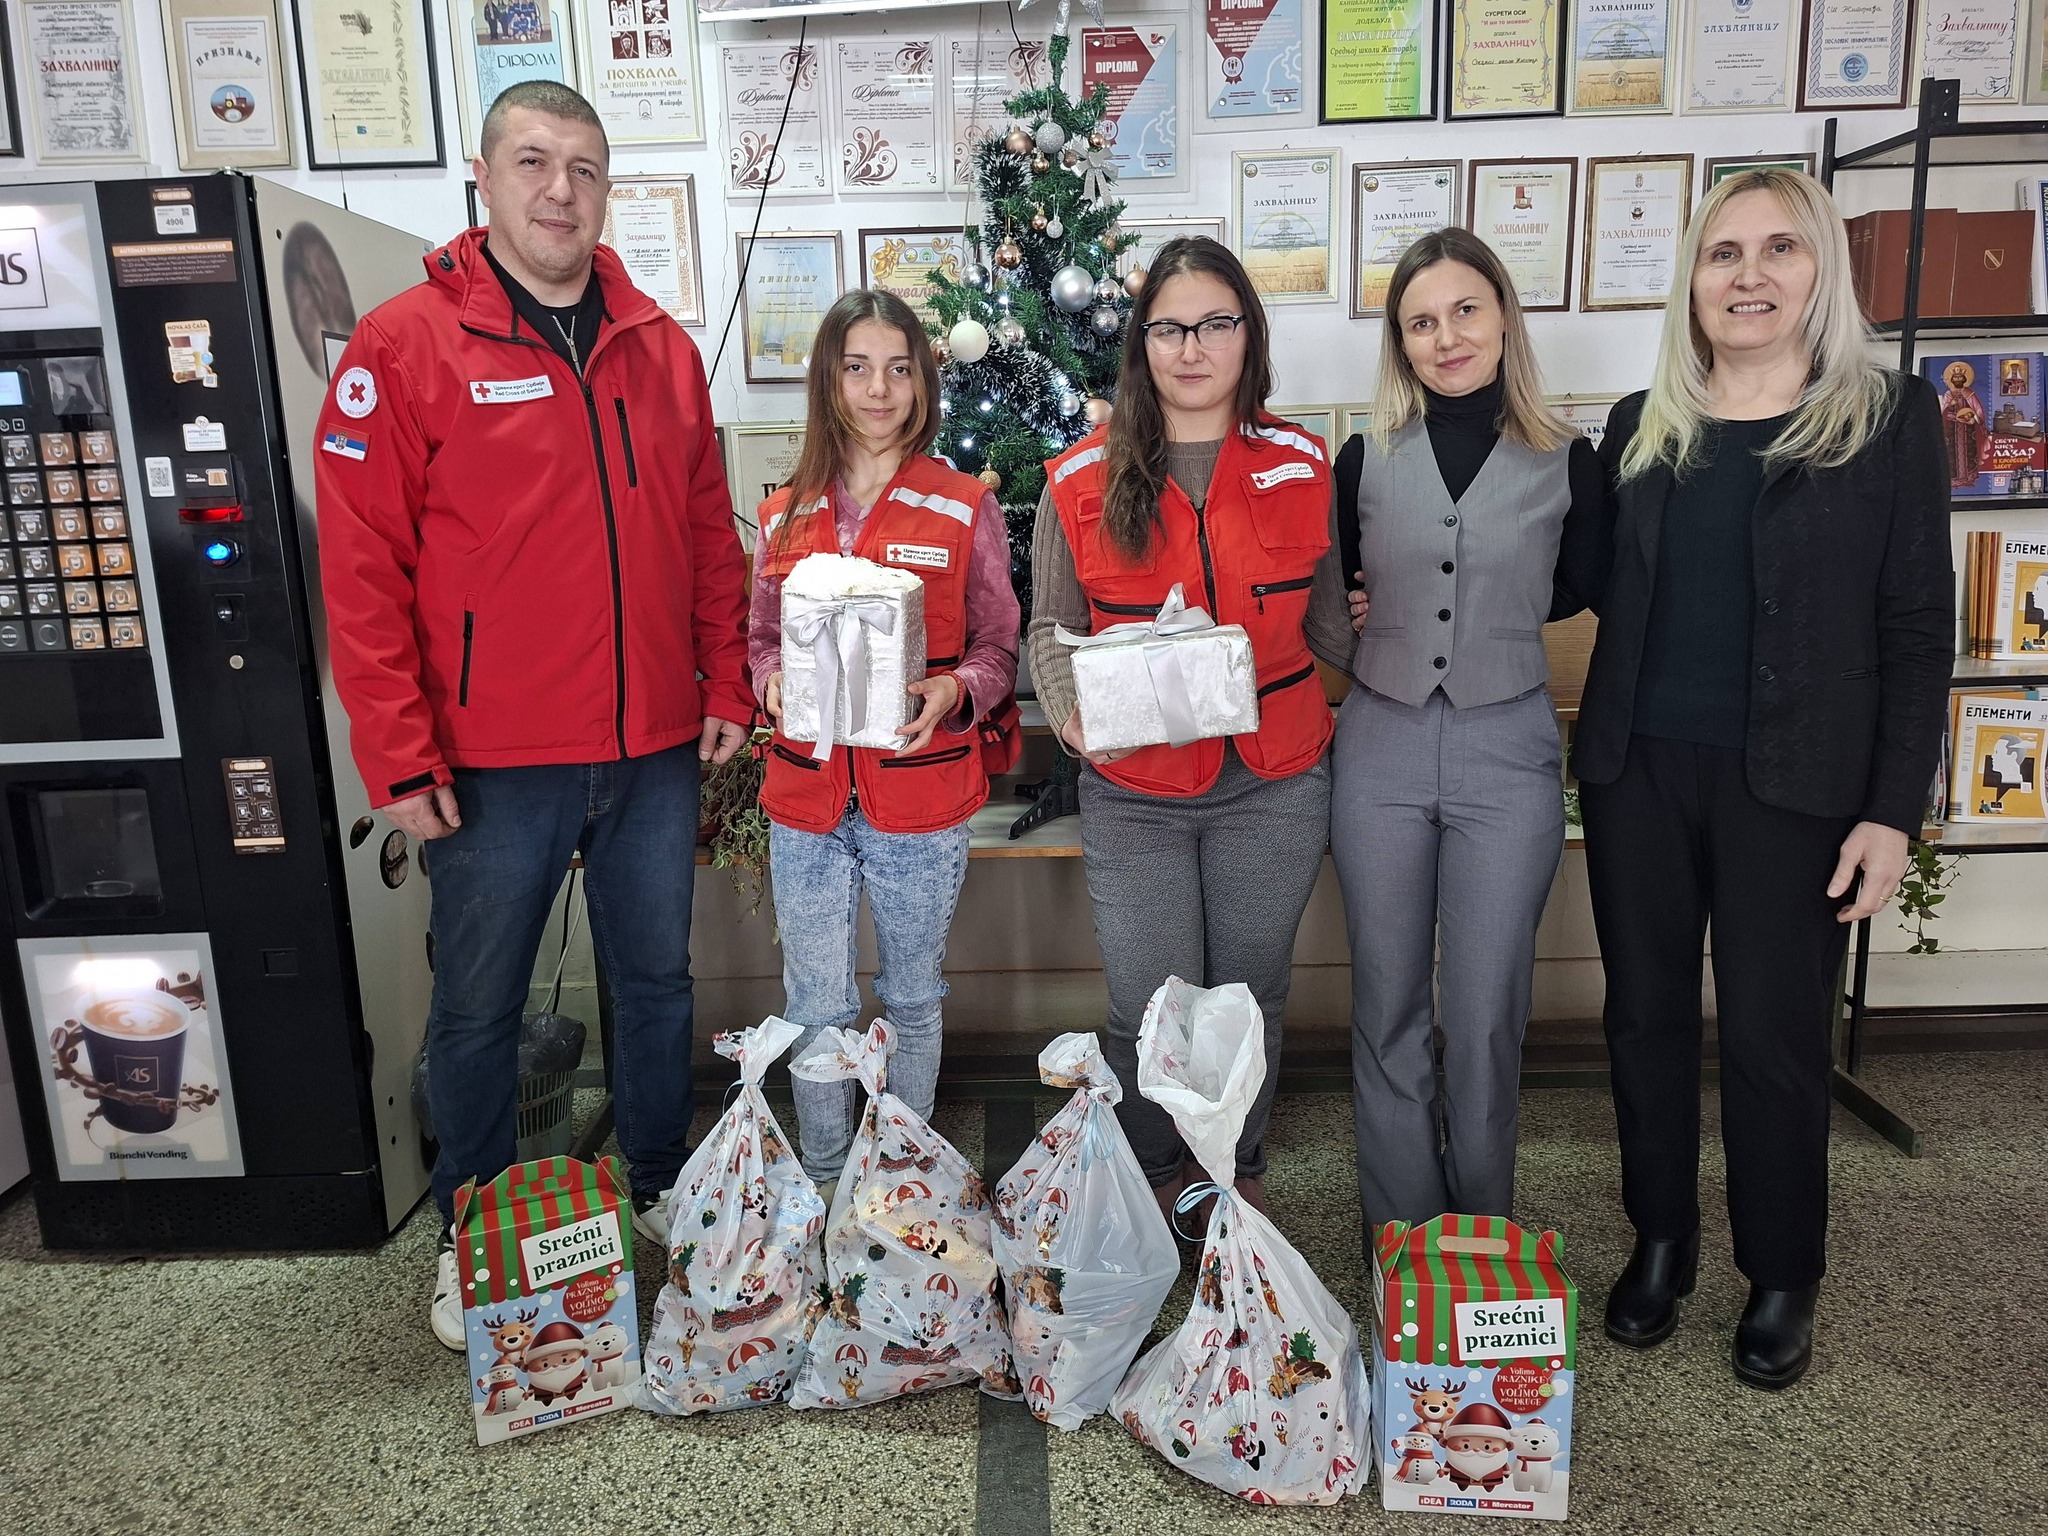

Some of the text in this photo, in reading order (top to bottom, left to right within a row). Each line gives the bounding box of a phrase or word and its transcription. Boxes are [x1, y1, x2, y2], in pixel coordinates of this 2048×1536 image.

[1221, 0, 1264, 10] DIPLOMA
[1589, 3, 1655, 12] ЗАХВАЛНИЦУ
[1936, 13, 2009, 37] Захвалницу
[1330, 46, 1358, 57] Средњој
[1381, 44, 1418, 55] Житорађа
[1473, 39, 1538, 50] ЗАХВАЛНИЦУ
[196, 48, 262, 66] ПРИЗНАЊЕ
[498, 53, 557, 68] DIPLOMA
[40, 60, 121, 73] ЗАХВАЛНИЦУ
[1096, 61, 1139, 74] DIPLOMA
[607, 67, 677, 80] ПОХВАЛА
[738, 88, 786, 106] Diploma
[852, 84, 900, 102] Diploma
[1254, 197, 1319, 207] ЗАХВАЛНИЦУ
[166, 218, 184, 226] 4906
[1374, 211, 1438, 221] ЗАХВАЛНИЦУ
[1493, 223, 1550, 235] ЗАХВАЛНИЦУ
[1600, 228, 1674, 240] ЗАХВАЛНИЦУ
[120, 247, 146, 255] AUTOMAT
[759, 275, 819, 284] ДИПЛОМУ
[192, 322, 208, 330] ČAŠA
[1993, 447, 2036, 459] ЛАЗАР
[2006, 543, 2048, 556] ЕЛЕМЕ
[1966, 707, 2032, 721] ЕЛЕМЕНТИ
[125, 1068, 151, 1084] AS
[109, 1150, 188, 1160] Bianchi Vending
[538, 1221, 603, 1256] Srećni
[533, 1237, 617, 1282] praznici
[576, 1280, 599, 1289] Volimo
[566, 1284, 609, 1300] PRAZNIKE
[570, 1296, 605, 1312] VOLIMO
[584, 1303, 608, 1316] DRUGE
[1473, 1304, 1546, 1328] Srećni
[1464, 1327, 1558, 1352] praznici
[1510, 1367, 1535, 1376] Volimo
[1497, 1375, 1546, 1384] PRAZNIKE
[1500, 1388, 1539, 1398] VOLIMO
[575, 1399, 611, 1413] Mercator
[1514, 1398, 1542, 1406] DRUGE
[538, 1412, 560, 1424] RODA
[511, 1419, 532, 1431] iDEA
[1271, 1425, 1312, 1477] Happy New Year
[1420, 1497, 1442, 1506] iDEA
[1450, 1499, 1474, 1508] RODA
[1492, 1501, 1532, 1510] Mercator
